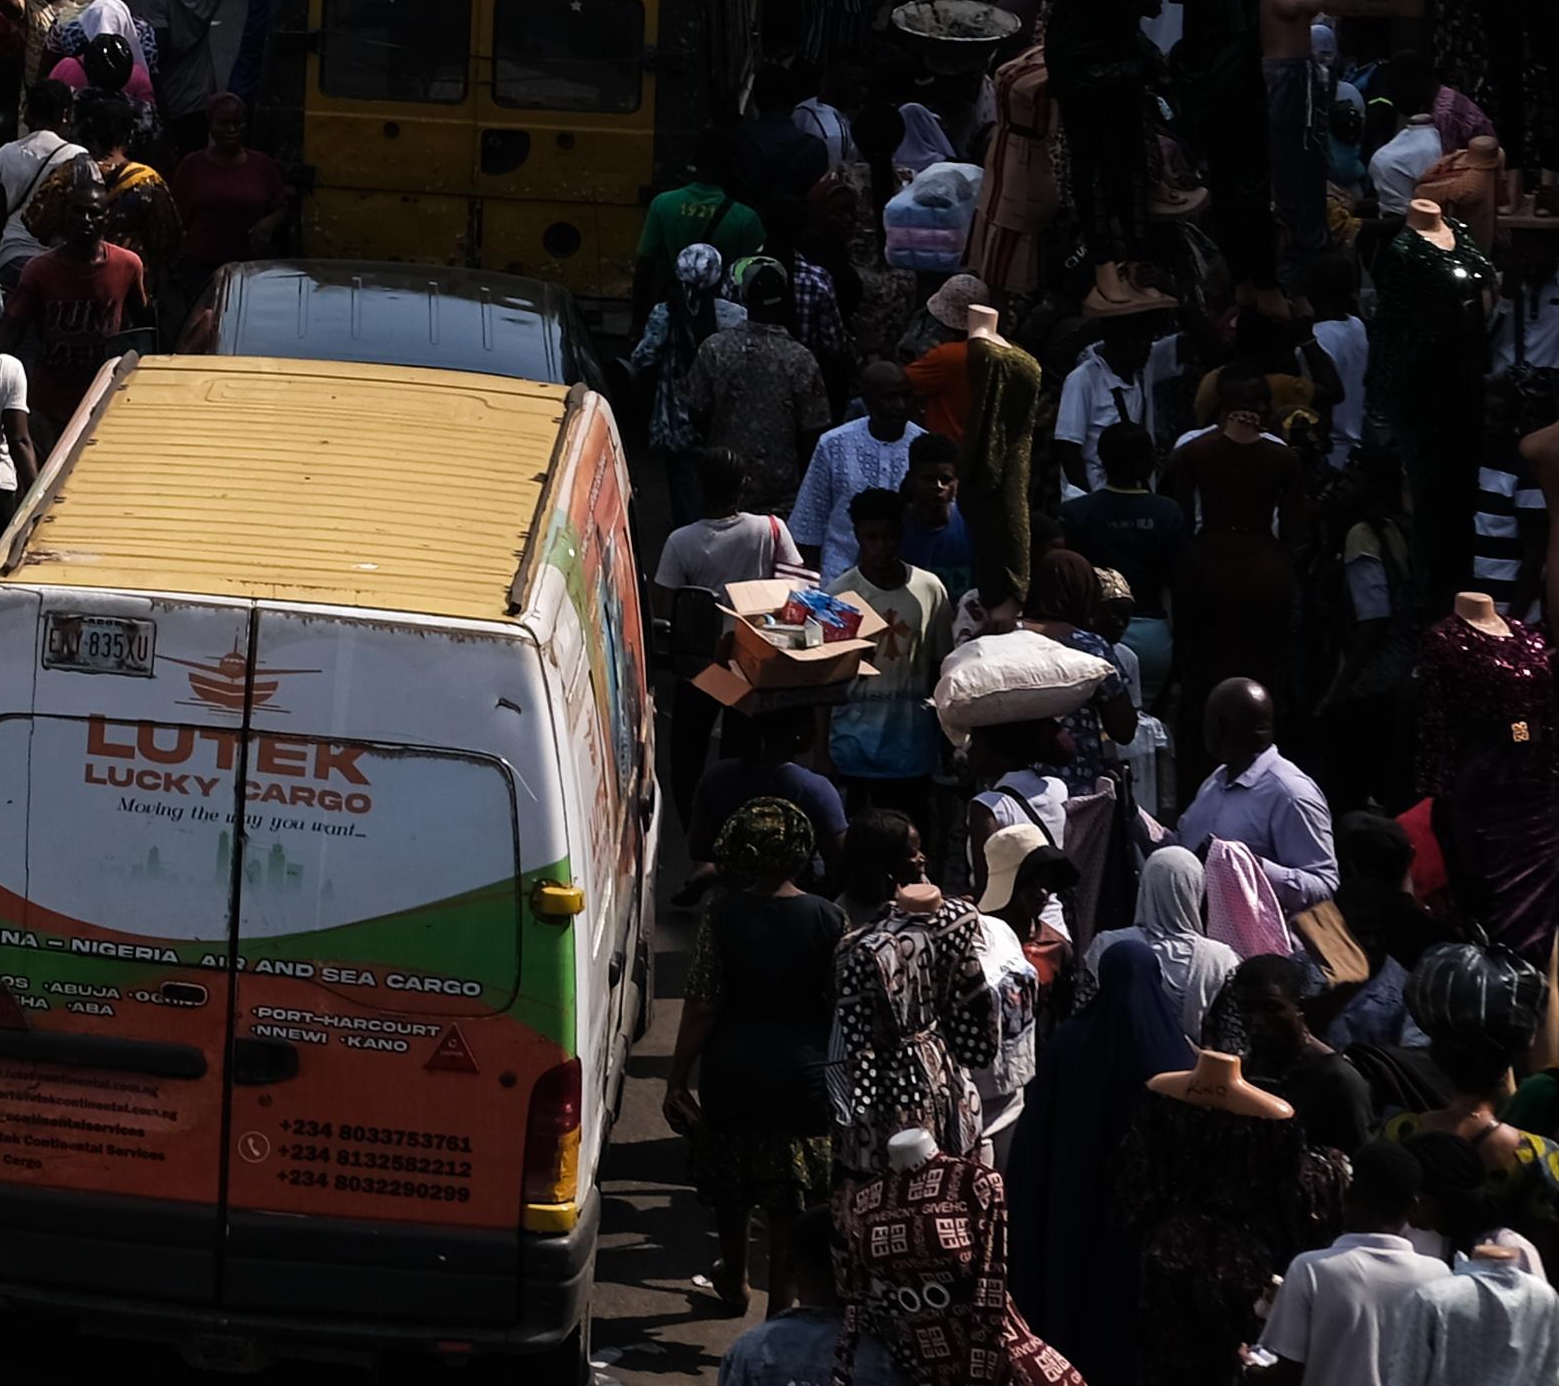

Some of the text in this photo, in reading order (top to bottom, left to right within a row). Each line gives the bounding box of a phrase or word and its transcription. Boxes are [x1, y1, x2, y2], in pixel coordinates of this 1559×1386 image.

[87, 713, 371, 786] LUTEK
[85, 763, 372, 814] LUCKY CARGO
[117, 797, 184, 821] Moving
[191, 806, 220, 823] the
[270, 817, 305, 832] you
[71, 938, 179, 963] NIGERIA
[201, 955, 246, 971] AIR
[255, 959, 315, 978] AND
[322, 968, 377, 987] SEA
[386, 975, 482, 996] CARGO
[50, 983, 121, 999] ABUJA
[70, 1002, 115, 1016] ABA
[257, 1025, 408, 1052] NNEWI KANO
[107, 1145, 166, 1161] Services
[279, 1119, 472, 1153] +234 8033753761
[3, 1155, 42, 1169] Cargo
[277, 1144, 472, 1178] +234 8132582212
[276, 1169, 471, 1203] +234 8032290299
